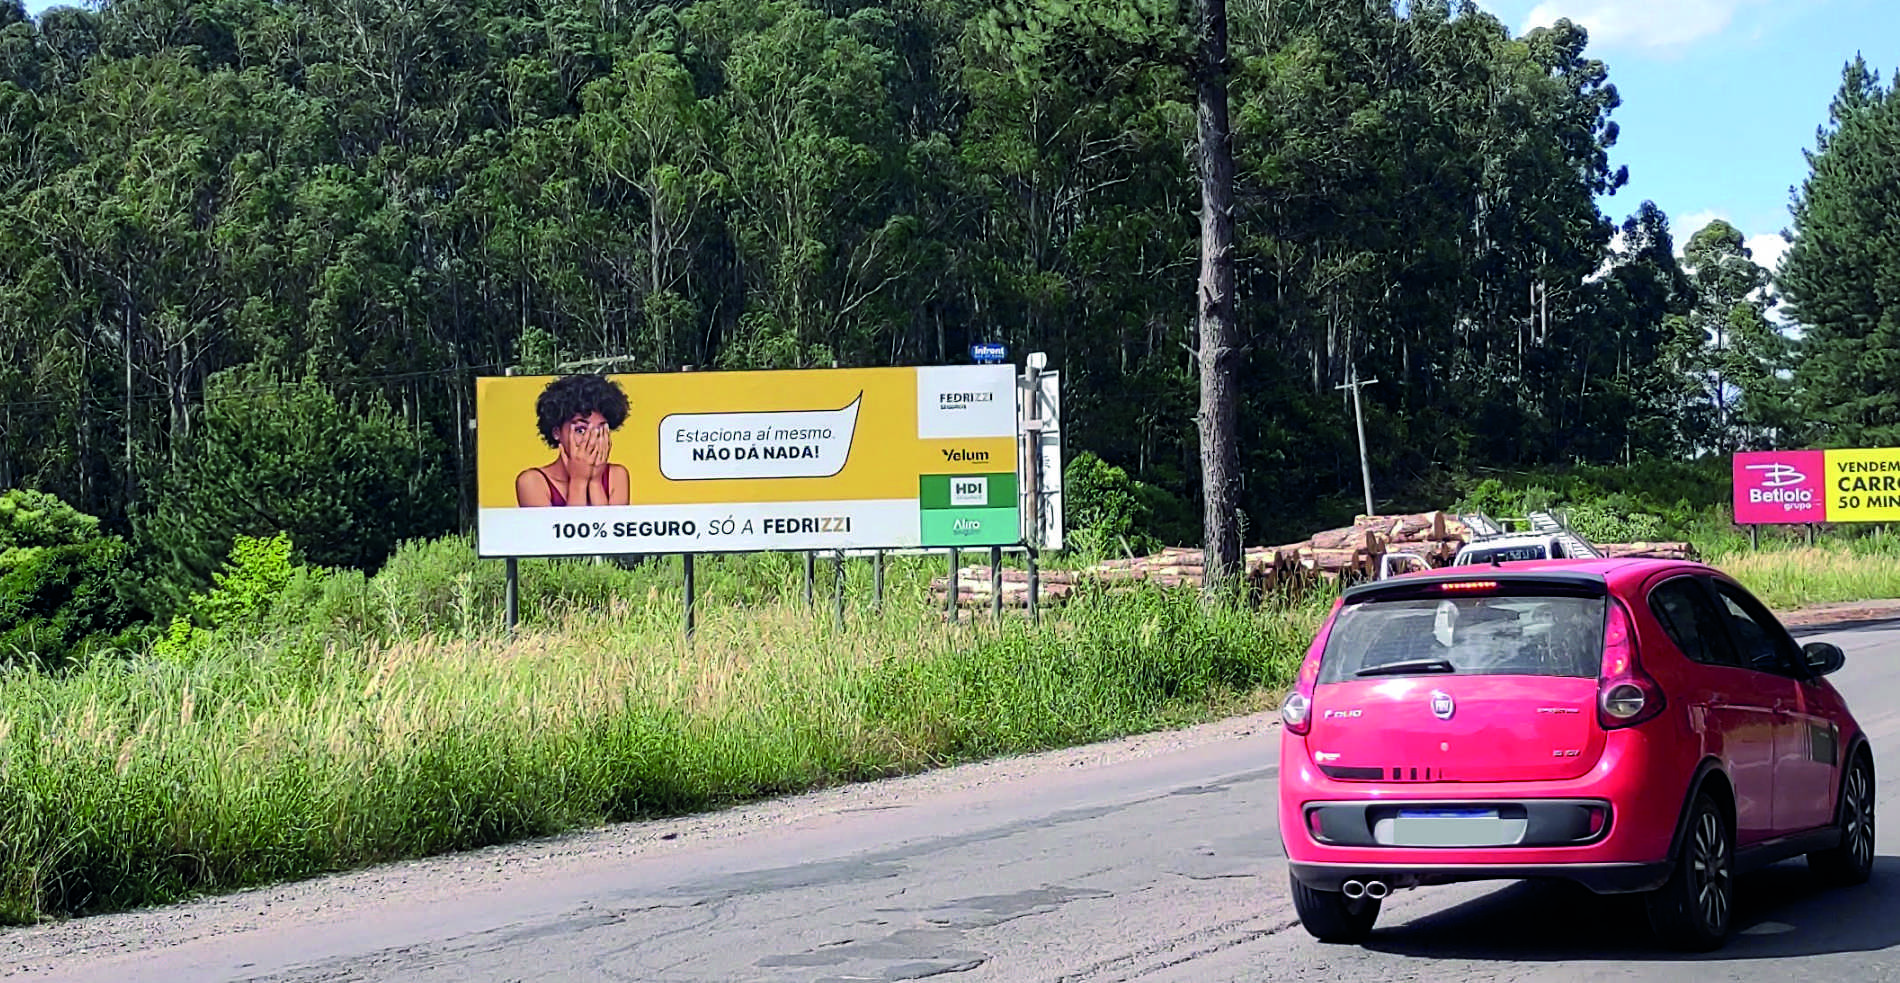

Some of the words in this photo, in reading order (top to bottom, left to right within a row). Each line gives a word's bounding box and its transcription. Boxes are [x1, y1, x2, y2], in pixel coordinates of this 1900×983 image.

[940, 392, 993, 403] FEDRIZZI
[676, 429, 751, 443] Estaciona
[756, 426, 772, 441] aí
[693, 445, 730, 461] NÃO
[735, 443, 759, 460] DÁ
[764, 445, 819, 459] NADA!
[941, 449, 989, 461] Yelum
[956, 483, 982, 494] HDI
[1838, 476, 1900, 492] CARR
[1783, 502, 1812, 511] grupo
[1838, 496, 1860, 509] 50
[553, 522, 608, 538] 100%
[612, 520, 701, 539] SEGURO,
[708, 514, 735, 535] SÓ
[741, 519, 754, 535] A
[763, 516, 851, 534] FEDRIZZI
